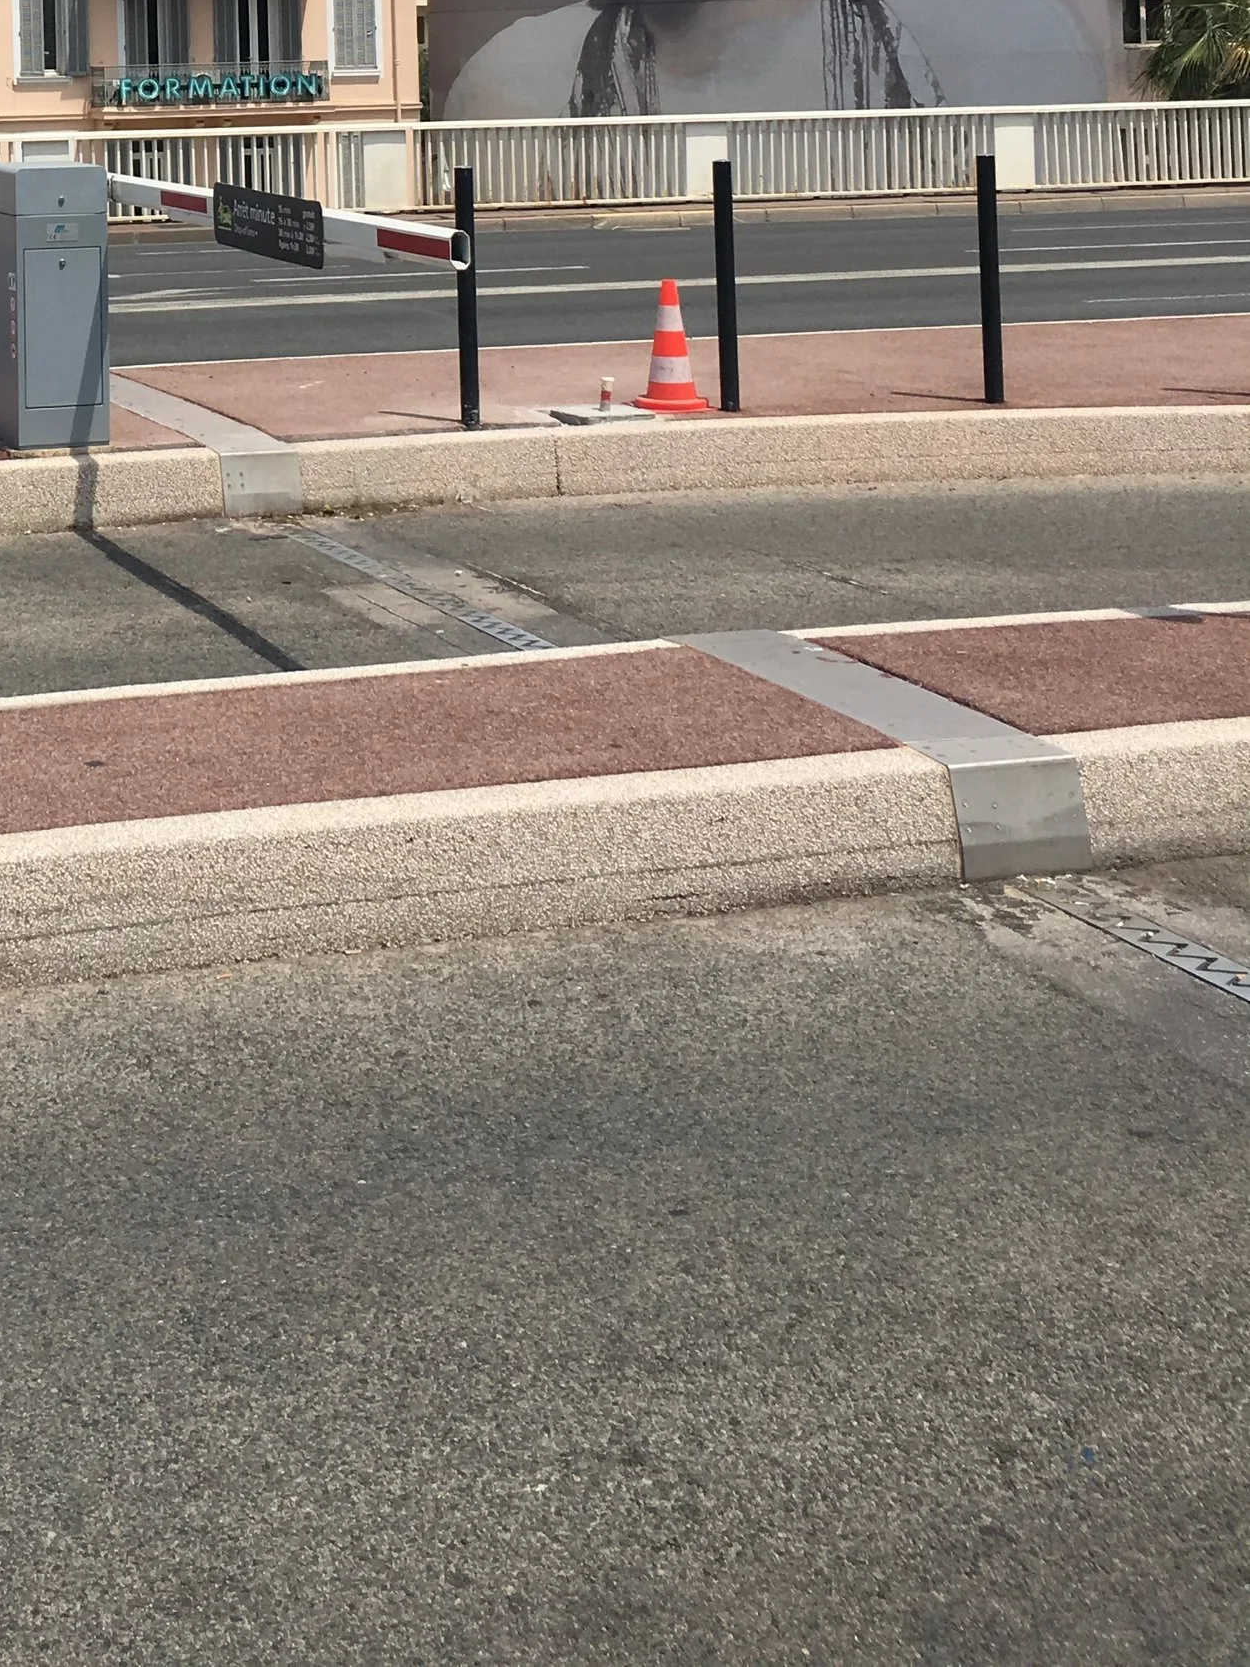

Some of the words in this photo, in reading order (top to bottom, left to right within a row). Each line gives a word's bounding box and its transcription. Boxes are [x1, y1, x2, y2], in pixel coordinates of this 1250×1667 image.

[120, 74, 318, 100] FORMATION
[233, 199, 249, 220] Arrêt
[250, 203, 276, 226] minute
